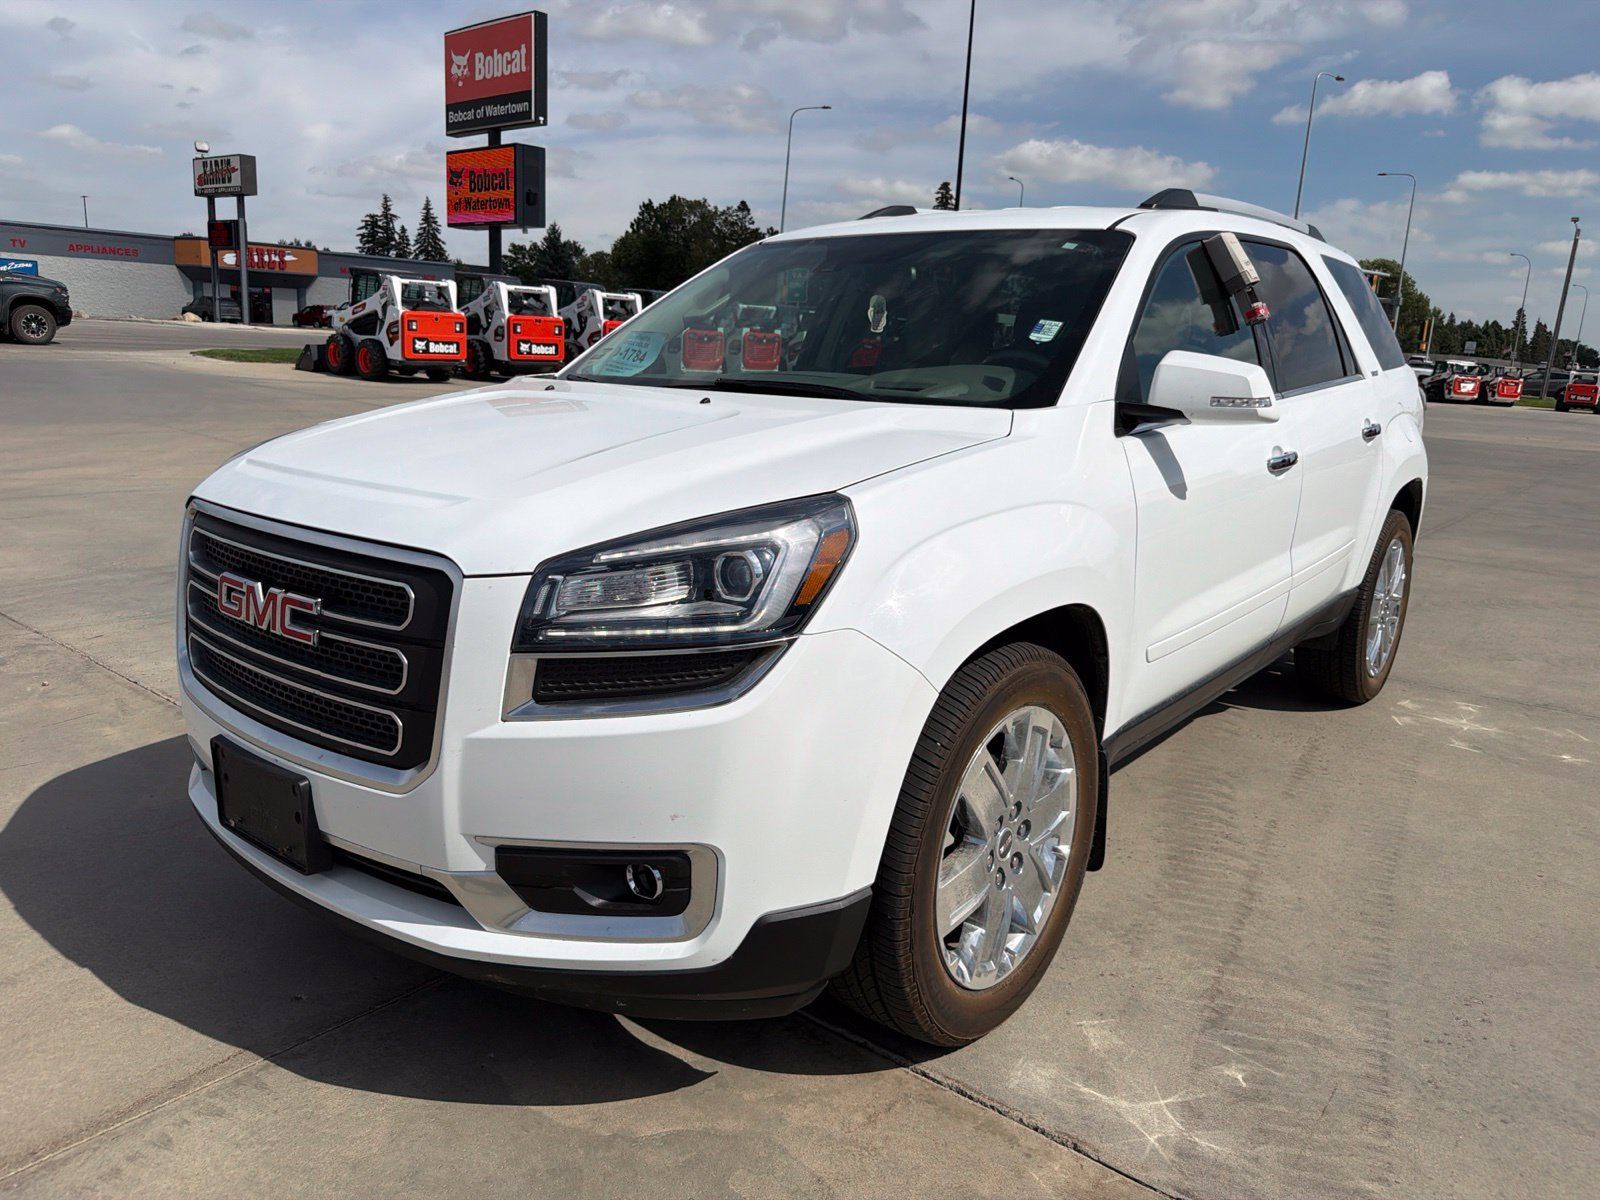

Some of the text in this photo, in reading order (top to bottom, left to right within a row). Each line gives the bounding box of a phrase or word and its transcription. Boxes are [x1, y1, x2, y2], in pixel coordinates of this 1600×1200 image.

[474, 43, 527, 81] Bobcat
[448, 101, 529, 123] Bobcat of Watertown
[469, 168, 511, 193] Bobcat
[454, 196, 511, 212] of Watertown
[10, 238, 26, 248] TV
[67, 243, 140, 258] APPLIANCES
[429, 342, 459, 354] Bobcat
[531, 344, 556, 355] Bobcat
[218, 571, 321, 648] GMC
